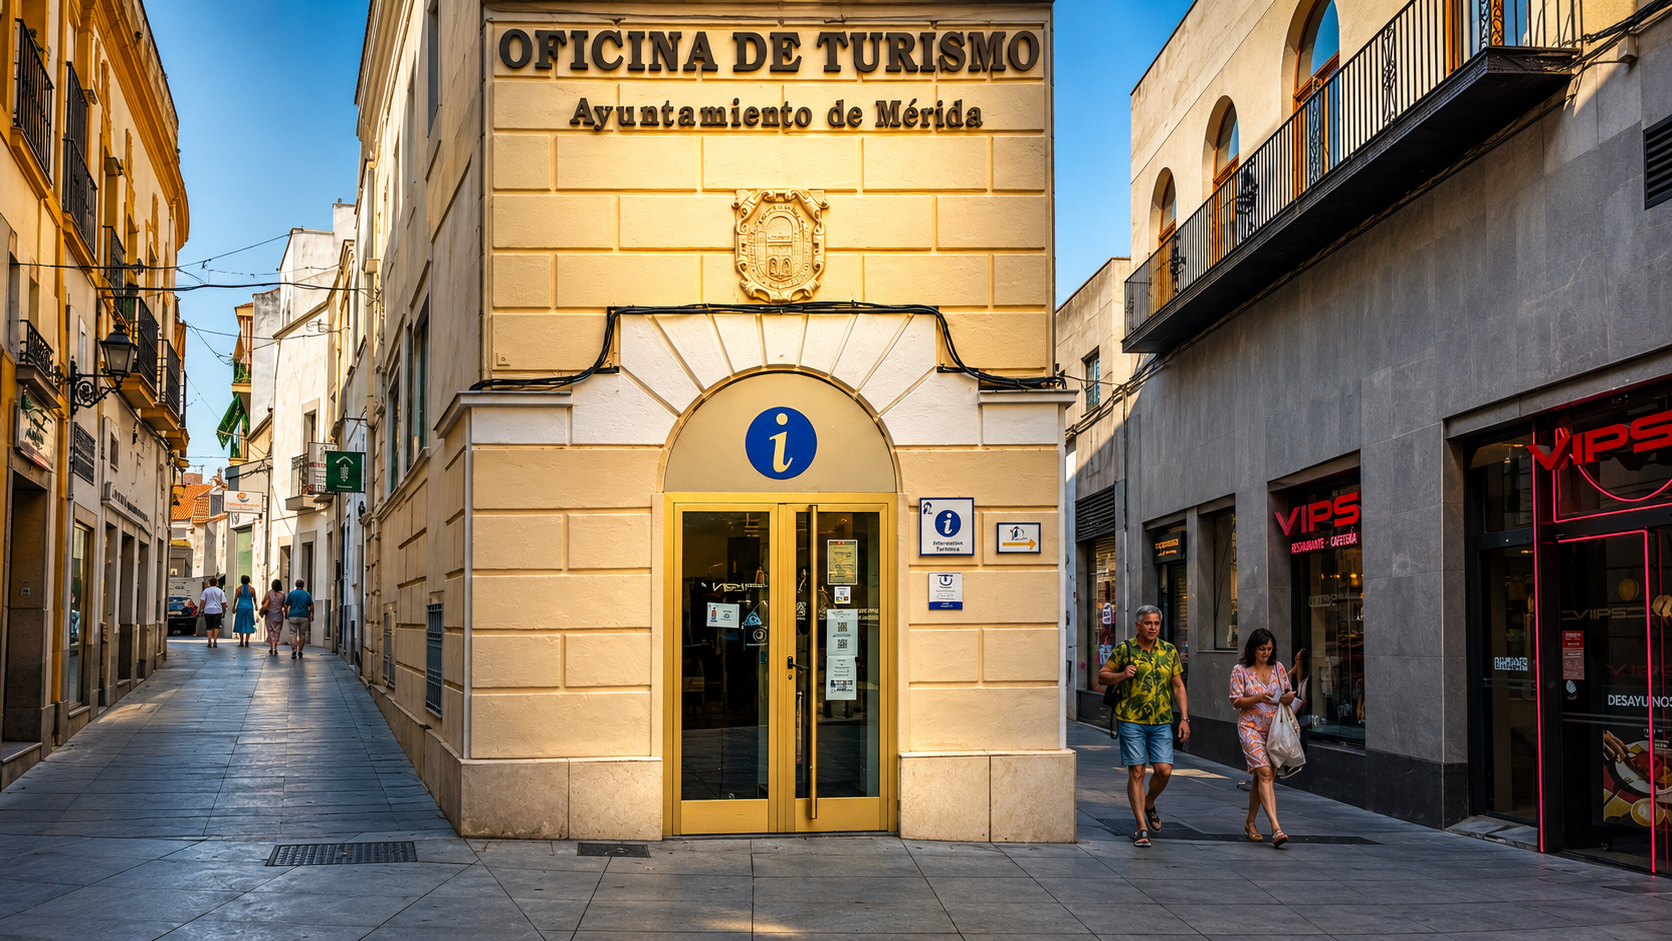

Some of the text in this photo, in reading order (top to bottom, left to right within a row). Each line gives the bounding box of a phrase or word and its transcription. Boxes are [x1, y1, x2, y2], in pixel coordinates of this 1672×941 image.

[499, 28, 1041, 73] OFICINA DE TURISMO
[570, 97, 983, 131] Ayuntamiento de Mérida
[1526, 409, 1672, 471] VIPS
[1274, 491, 1361, 537] VIPS
